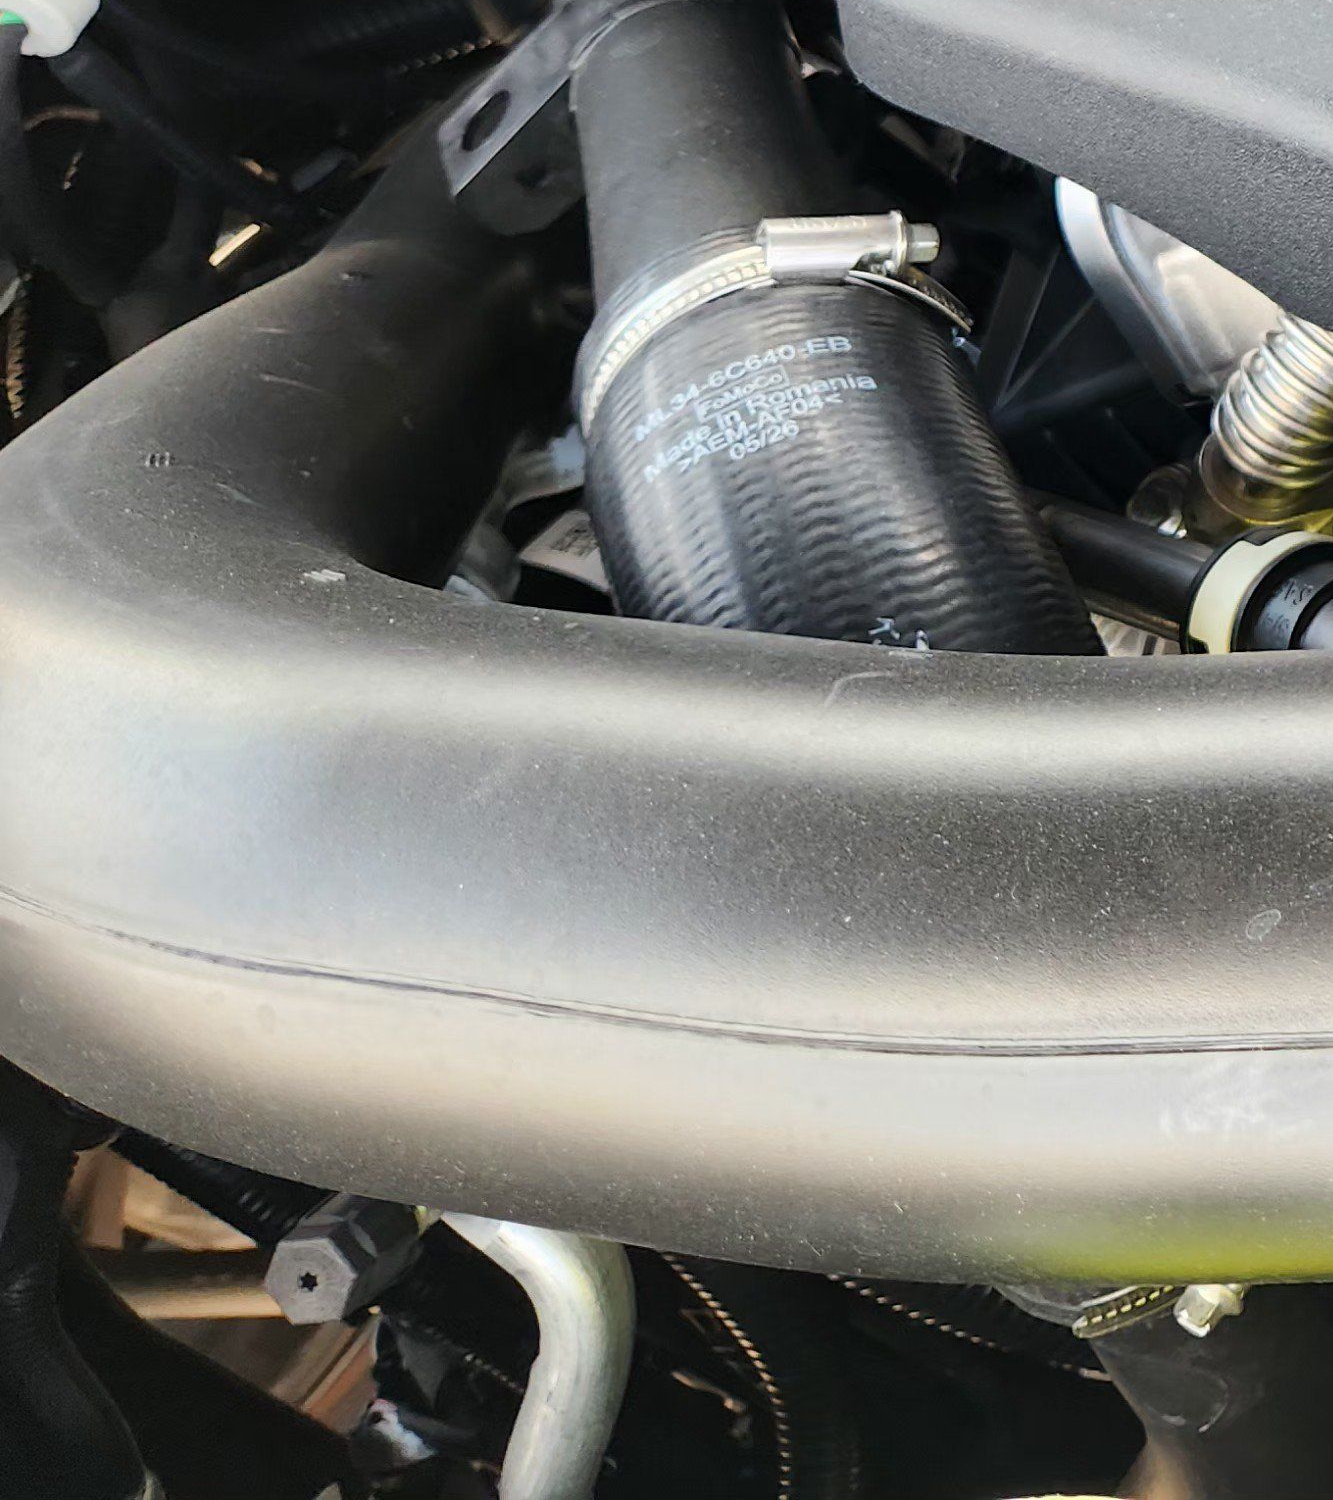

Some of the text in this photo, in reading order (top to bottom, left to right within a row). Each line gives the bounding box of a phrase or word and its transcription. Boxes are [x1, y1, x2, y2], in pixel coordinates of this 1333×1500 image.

[643, 424, 712, 483] Made
[745, 372, 878, 415] Romania
[697, 370, 785, 418] FoMoCo
